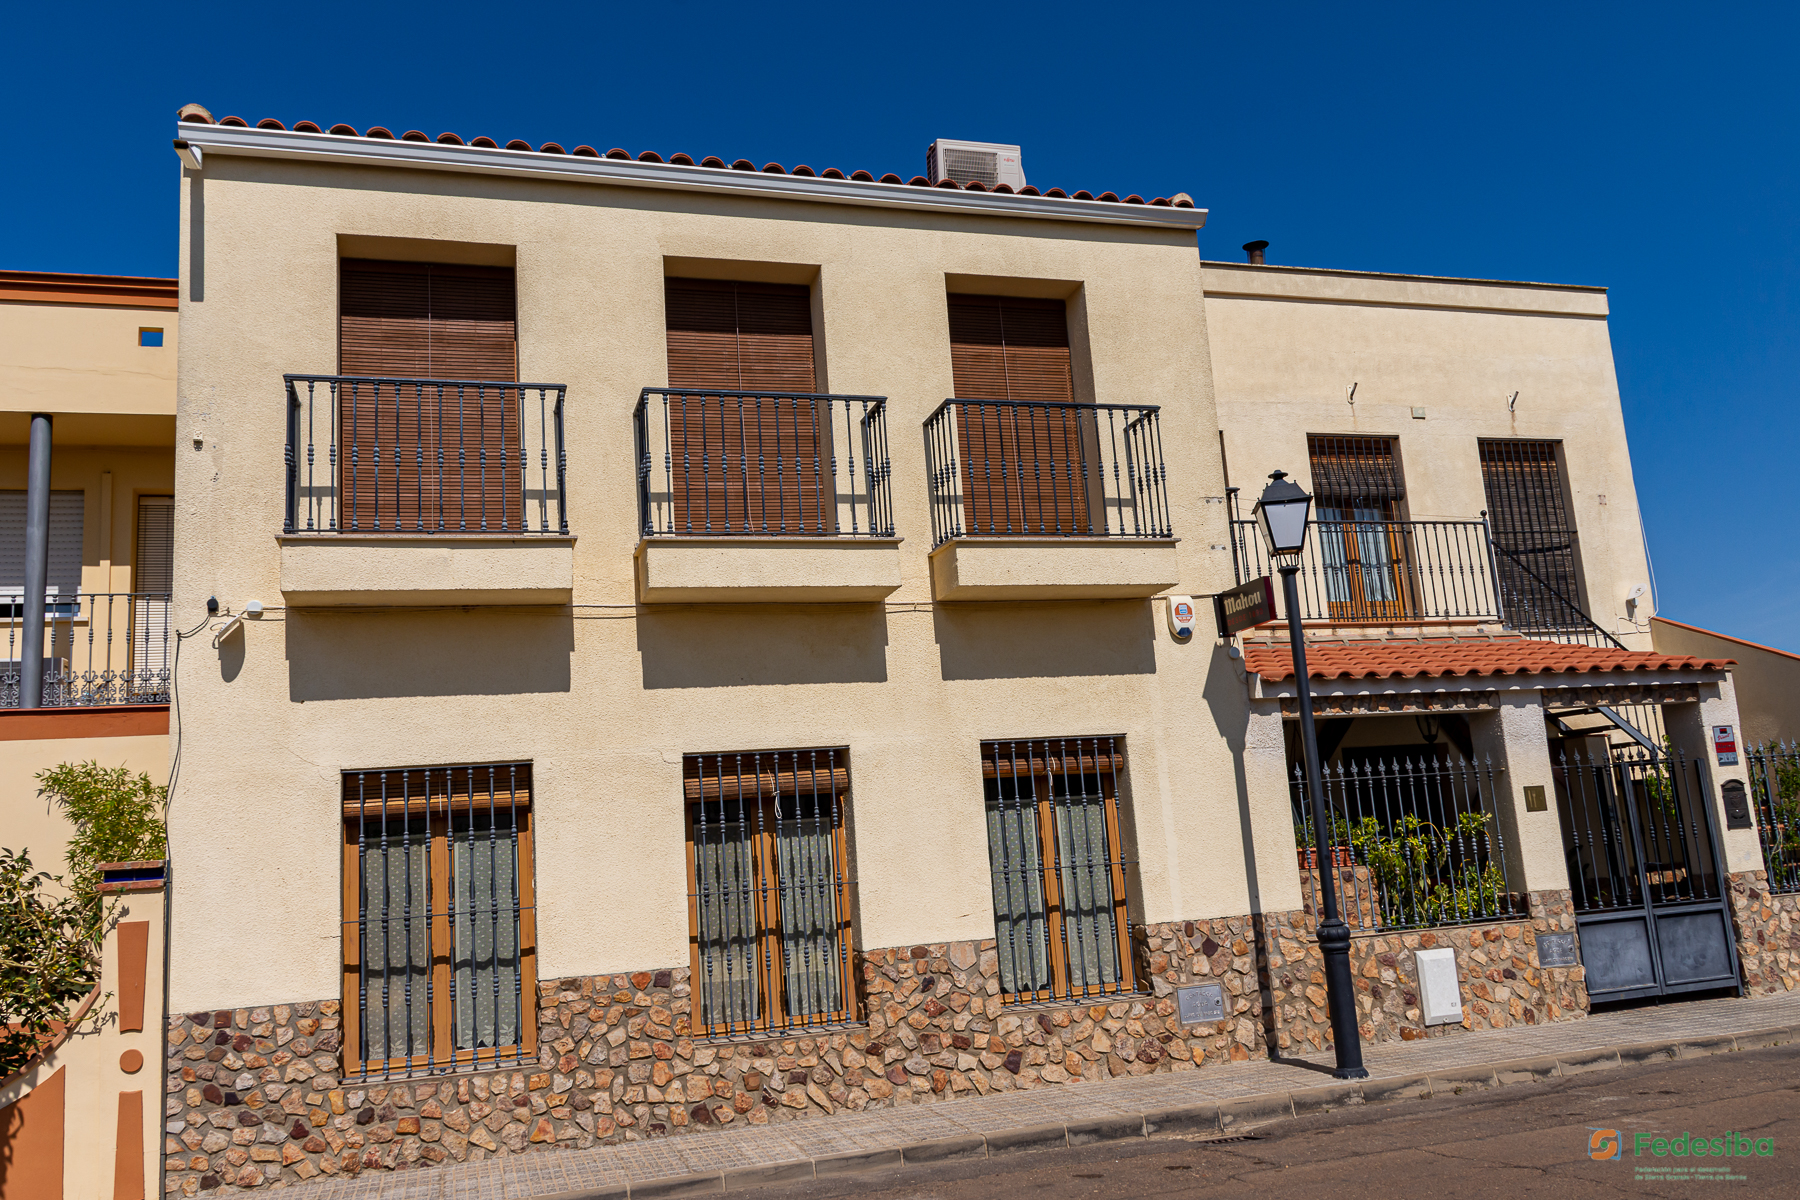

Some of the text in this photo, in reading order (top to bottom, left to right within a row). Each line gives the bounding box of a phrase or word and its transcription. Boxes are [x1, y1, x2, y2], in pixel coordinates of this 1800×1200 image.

[1223, 591, 1262, 615] Mahou
[1227, 608, 1264, 627] DESDE 1890
